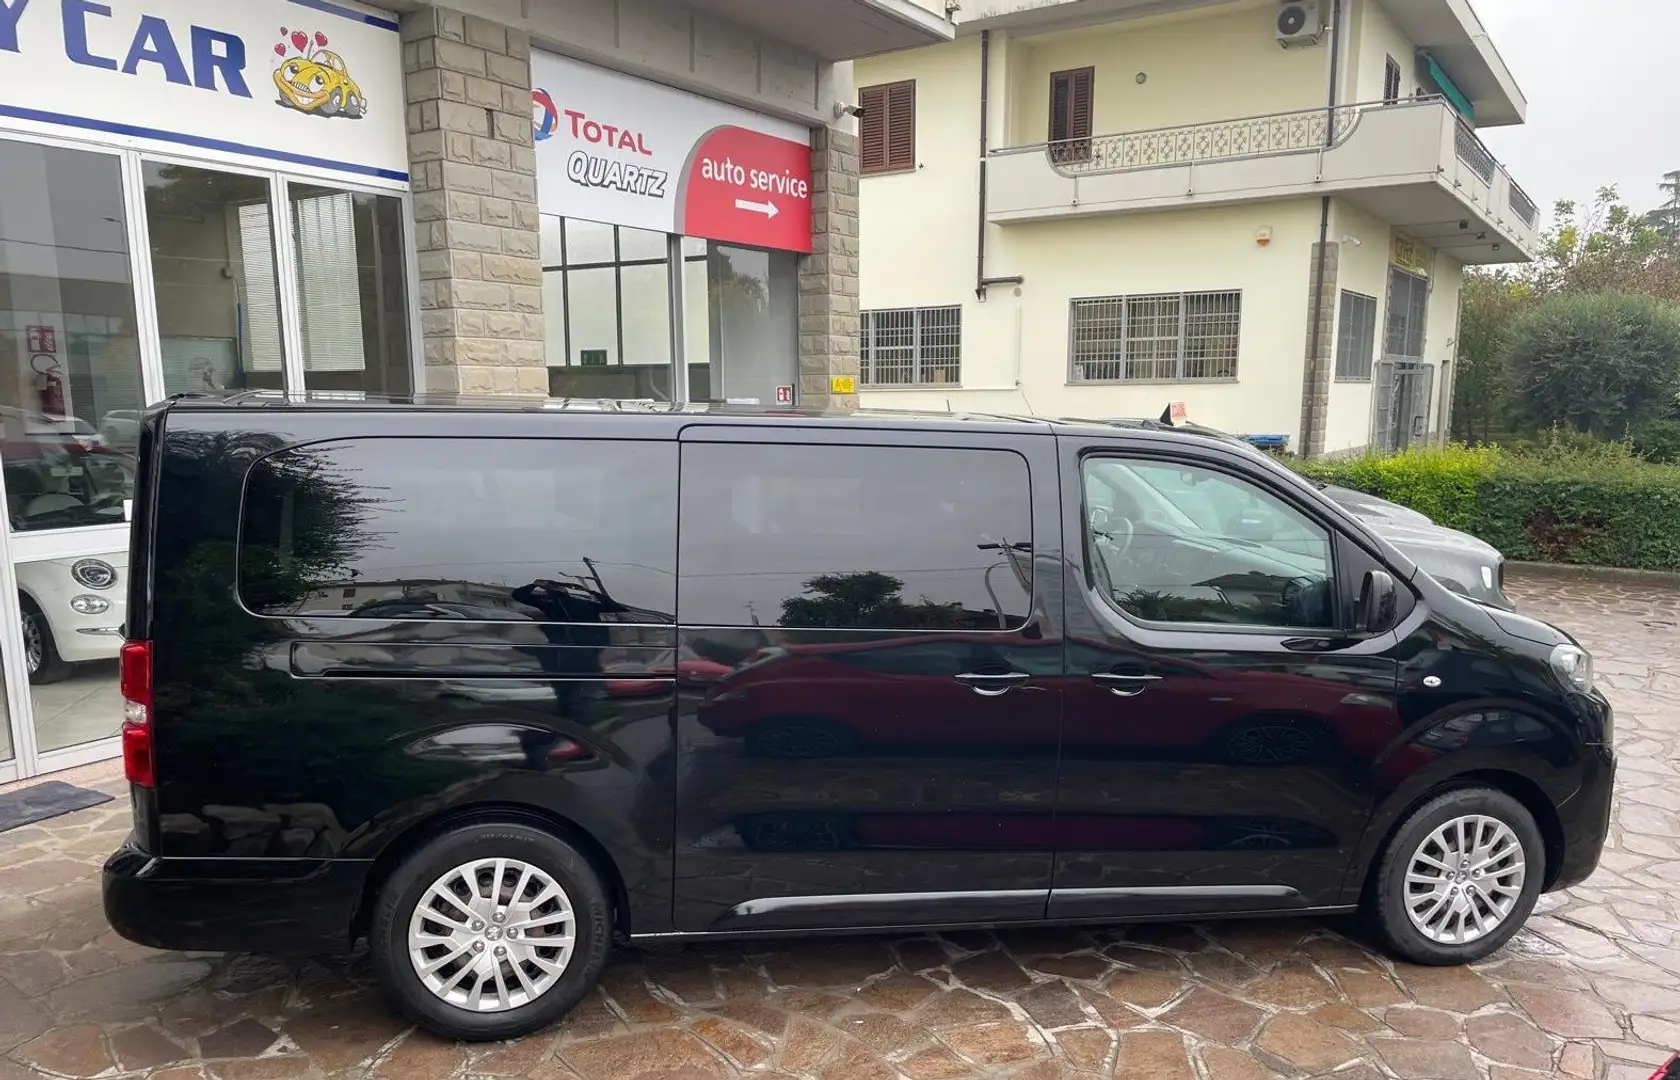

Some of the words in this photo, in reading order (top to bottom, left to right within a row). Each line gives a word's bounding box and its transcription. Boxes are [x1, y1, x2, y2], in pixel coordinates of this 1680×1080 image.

[61, 0, 253, 98] CAR
[564, 109, 652, 156] TOTAL
[567, 151, 667, 198] QUARTZ
[702, 157, 745, 186] auto
[750, 167, 808, 200] service
